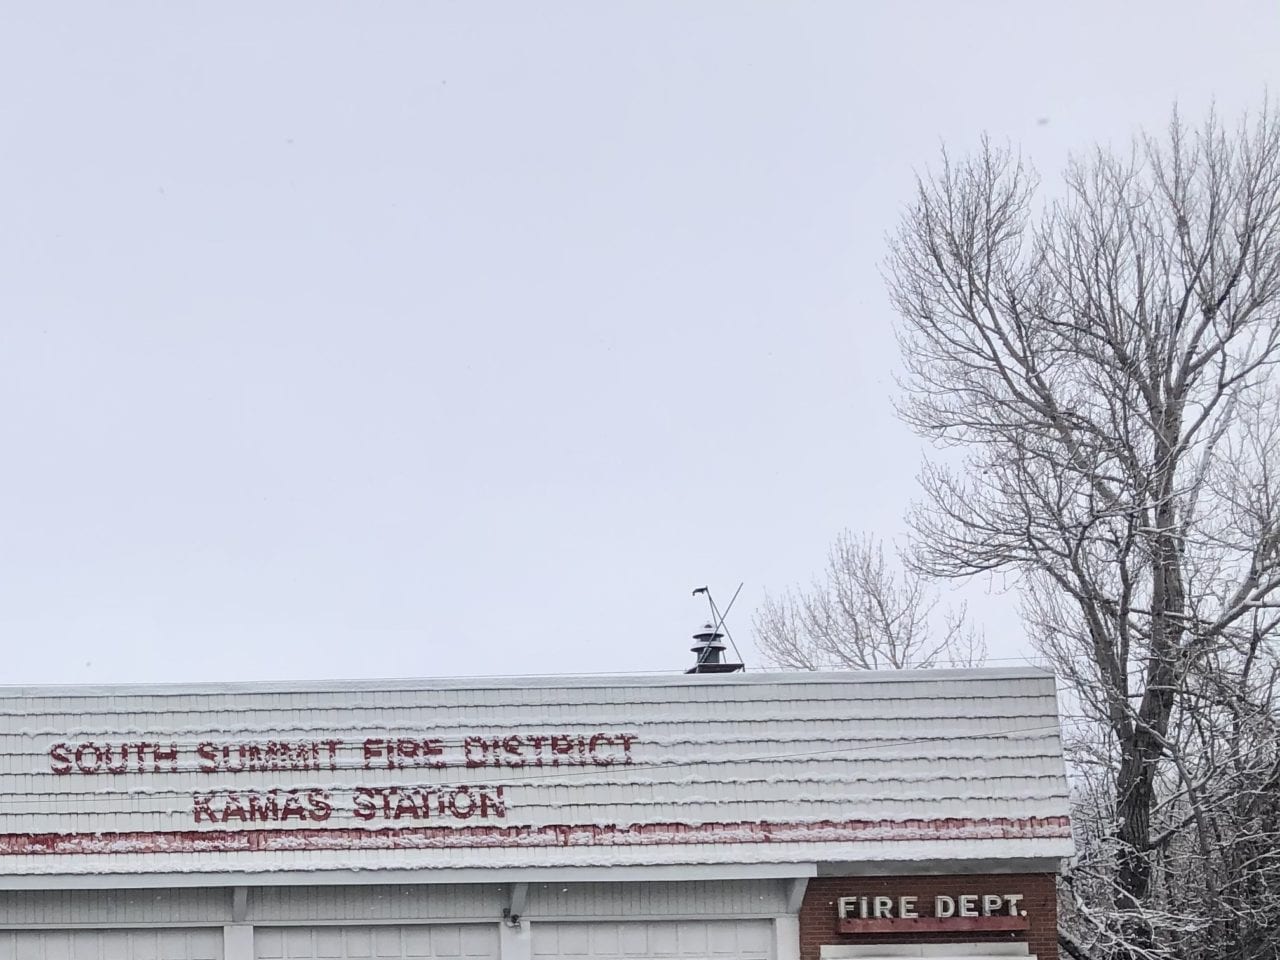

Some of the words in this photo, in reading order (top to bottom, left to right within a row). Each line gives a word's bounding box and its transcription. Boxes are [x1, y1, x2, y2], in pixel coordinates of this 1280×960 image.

[50, 741, 178, 775] SOUTH
[197, 738, 344, 774] SUMMIT
[363, 737, 447, 770] FIRE
[464, 732, 639, 769] DISTRICT
[193, 787, 333, 824] KAMAS
[352, 784, 507, 821] STATION
[837, 896, 919, 919] FIRE
[934, 894, 1028, 918] DEPT.
